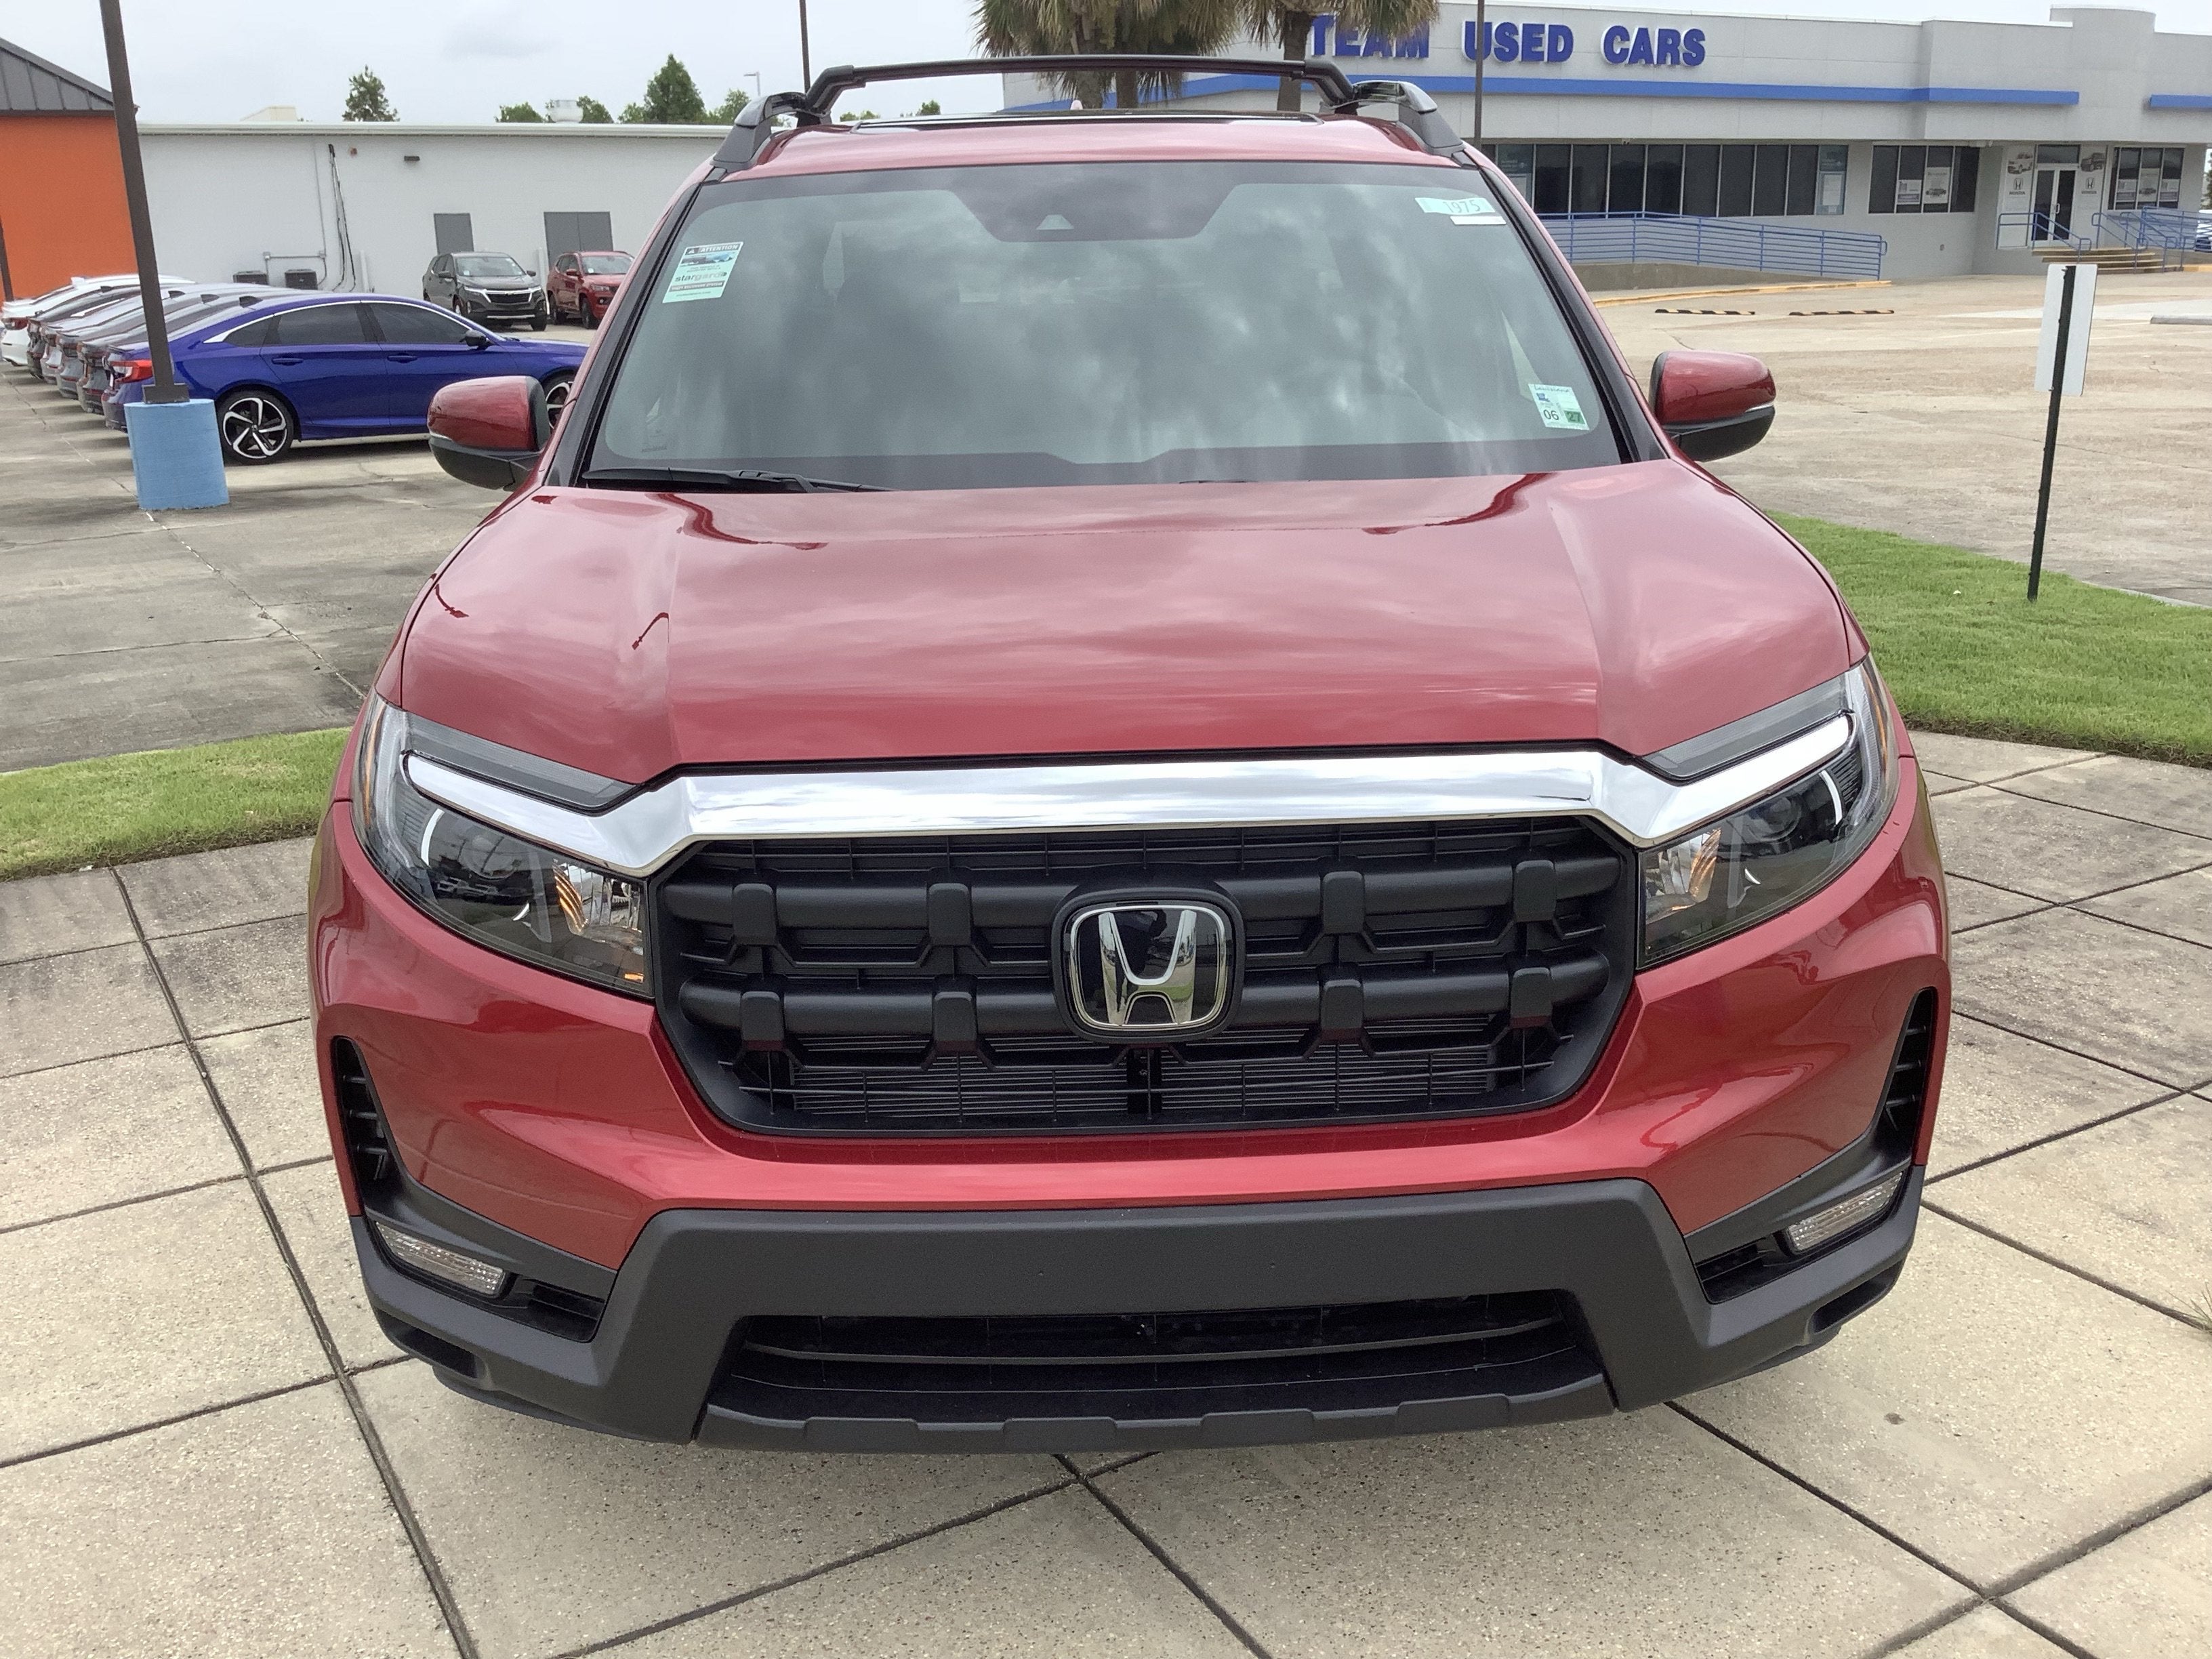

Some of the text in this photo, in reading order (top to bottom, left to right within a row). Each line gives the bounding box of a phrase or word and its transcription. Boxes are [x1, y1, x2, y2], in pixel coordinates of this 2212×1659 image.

[1462, 21, 1574, 62] USED
[1601, 25, 1706, 66] CARS
[1443, 200, 1480, 213] 1975
[700, 245, 739, 253] ATTENTION
[1543, 409, 1559, 421] 06
[1566, 411, 1580, 422] 27
